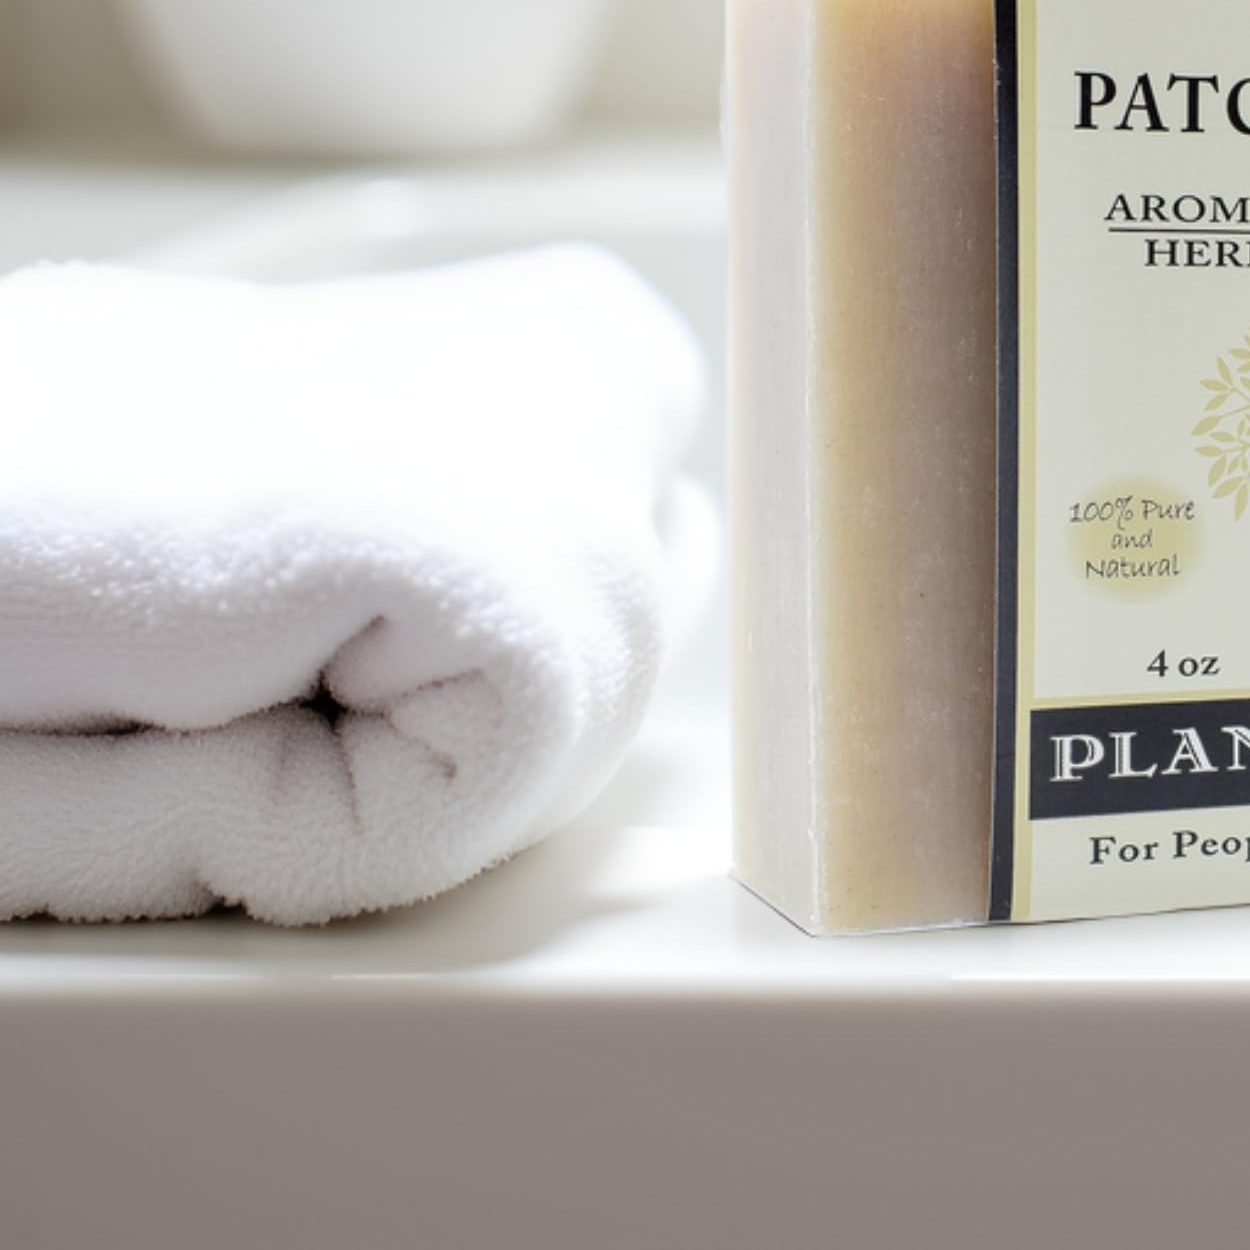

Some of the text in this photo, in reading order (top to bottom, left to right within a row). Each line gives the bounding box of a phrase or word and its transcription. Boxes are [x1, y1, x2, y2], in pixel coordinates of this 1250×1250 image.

[1069, 495, 1196, 530] 100% Pure
[1111, 528, 1154, 549] and
[1084, 557, 1182, 580] Natural
[1147, 650, 1220, 678] 4 oz
[1089, 835, 1160, 865] For
